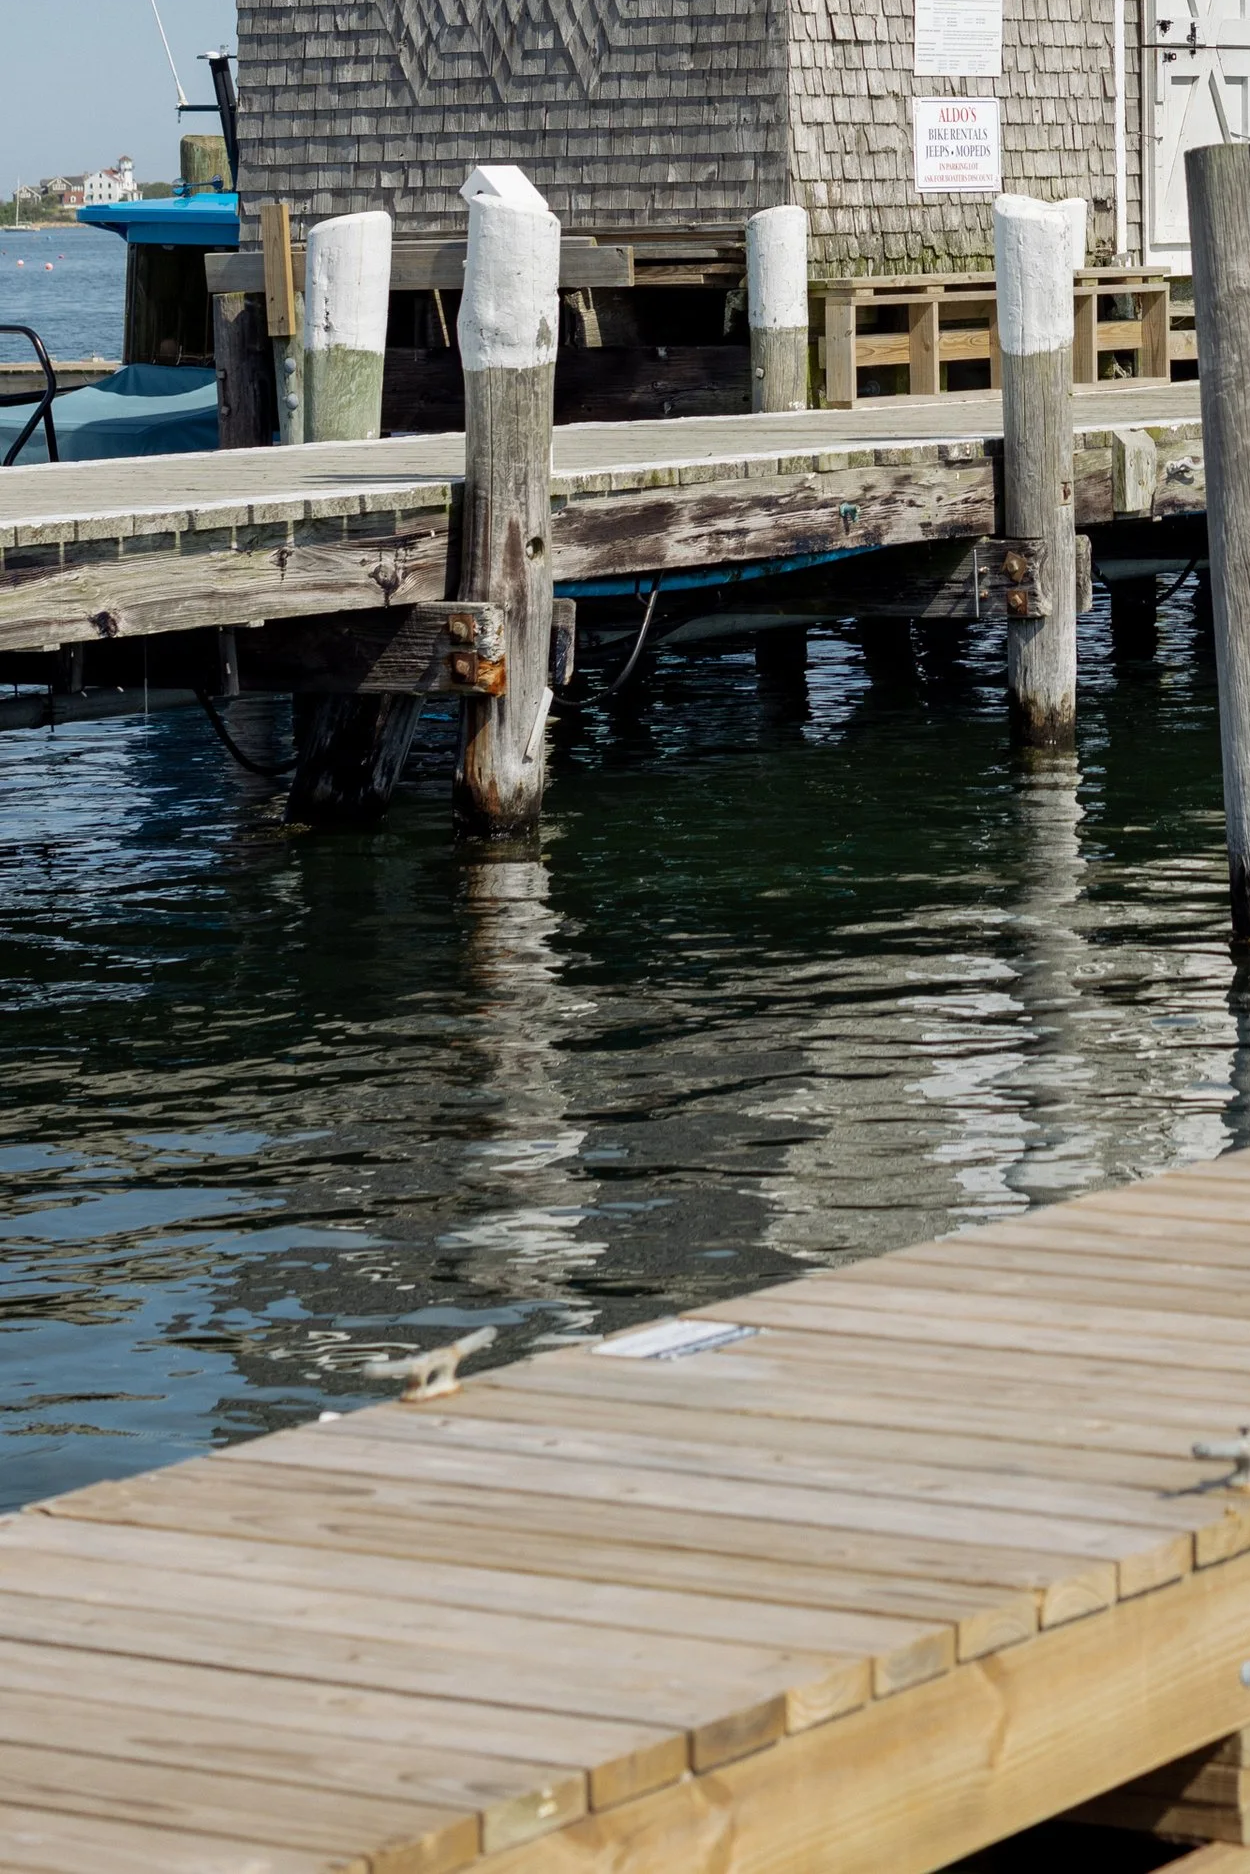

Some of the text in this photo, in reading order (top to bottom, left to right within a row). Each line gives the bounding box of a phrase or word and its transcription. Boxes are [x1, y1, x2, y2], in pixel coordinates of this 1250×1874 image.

[938, 107, 977, 123] ALDO'S
[928, 128, 988, 141] BIKE RENTALS
[925, 145, 991, 159] JEEPS MOPEDS
